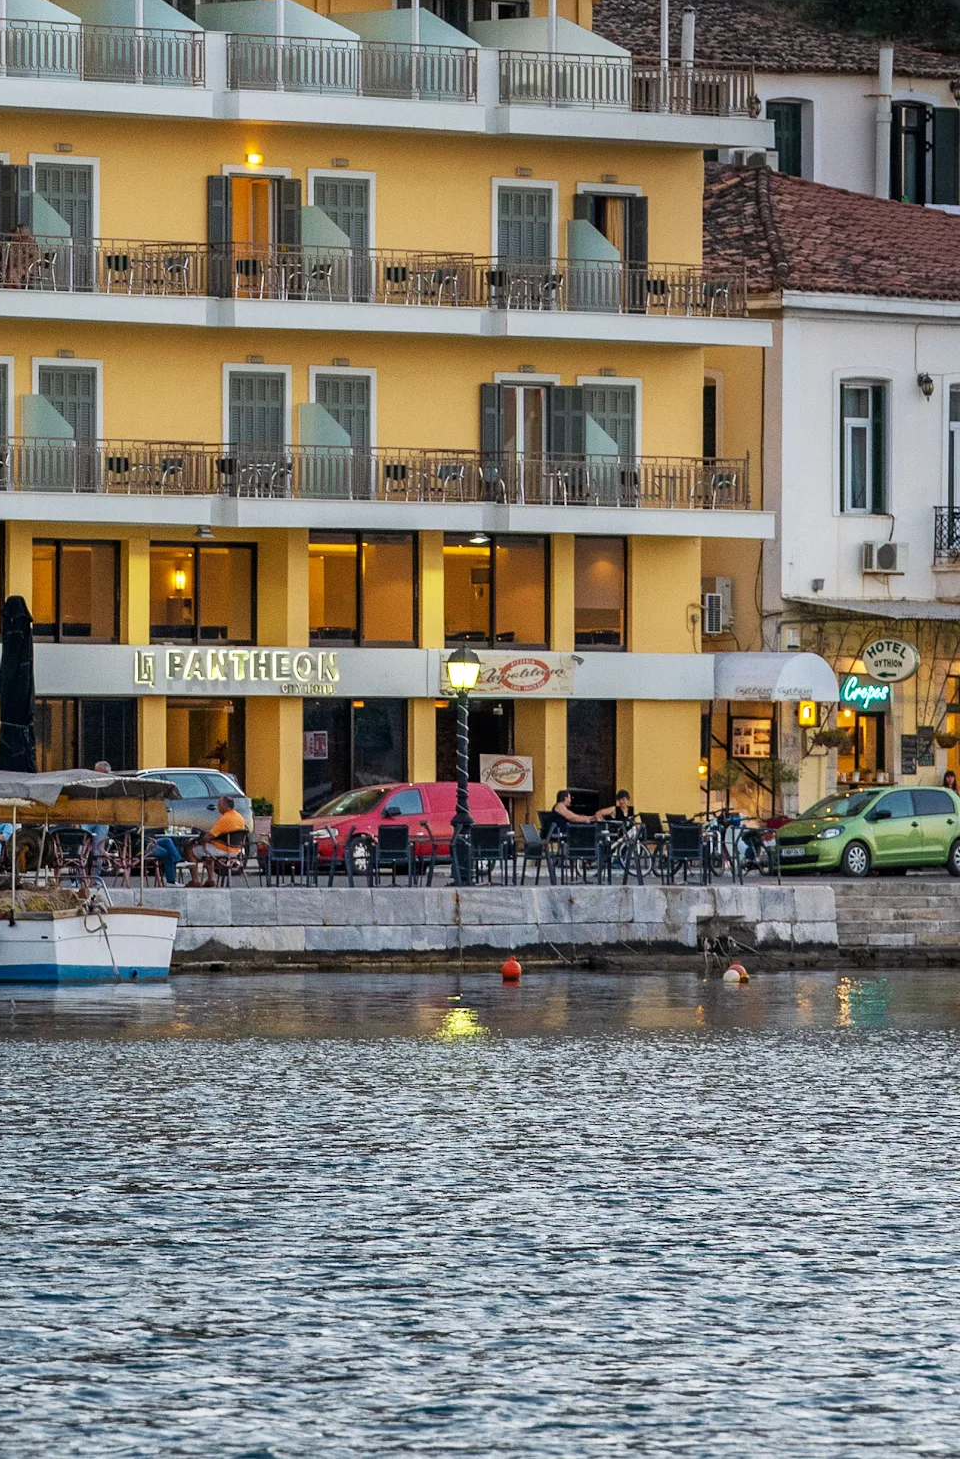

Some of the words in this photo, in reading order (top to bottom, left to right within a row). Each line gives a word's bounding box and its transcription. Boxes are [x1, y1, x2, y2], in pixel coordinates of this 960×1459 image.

[866, 641, 908, 660] HOTEL
[874, 658, 903, 668] GYTHION
[165, 648, 340, 682] PANTHEON
[843, 675, 890, 710] Crepes
